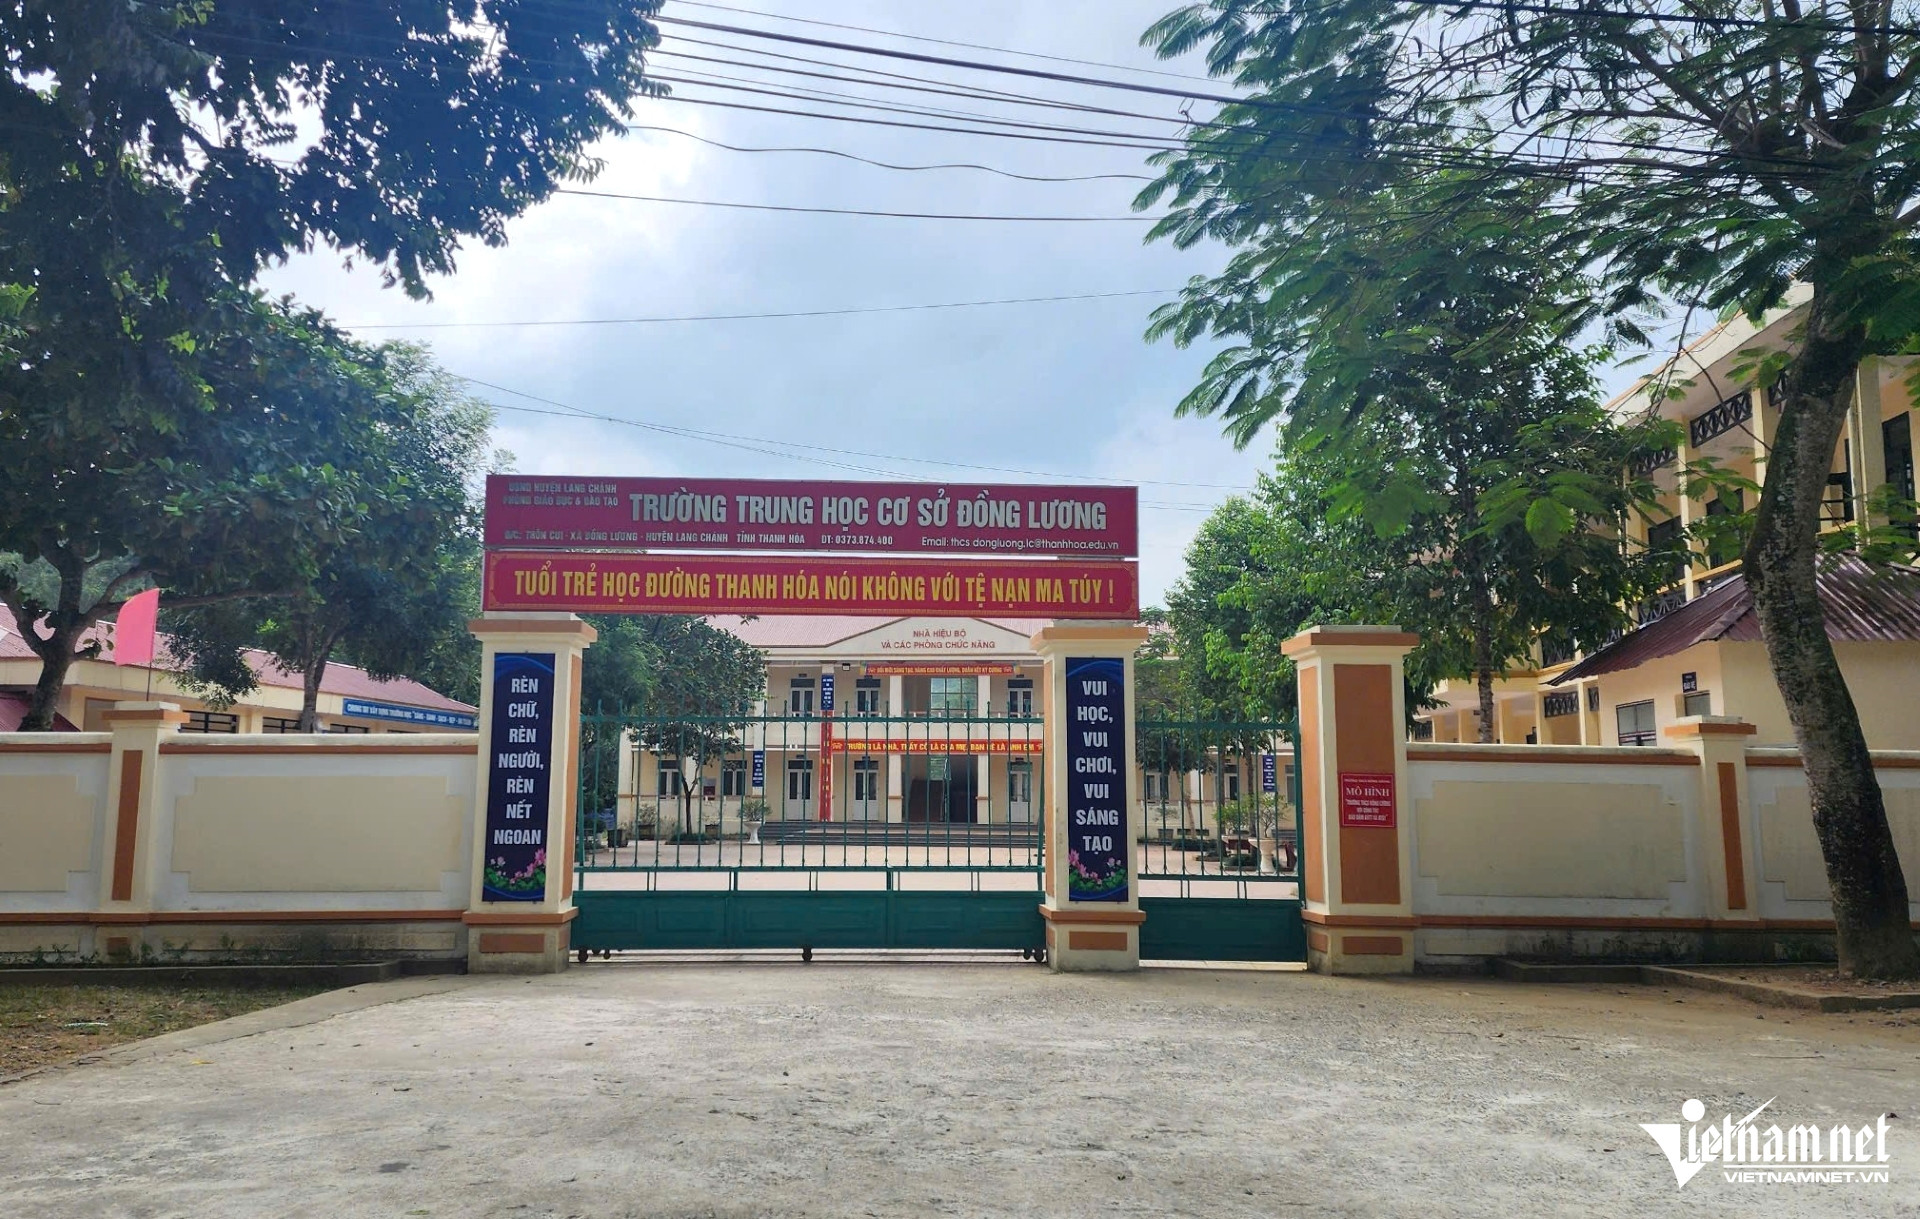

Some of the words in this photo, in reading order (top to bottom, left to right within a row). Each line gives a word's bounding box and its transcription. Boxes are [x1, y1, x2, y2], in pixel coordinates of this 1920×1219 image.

[564, 483, 585, 493] LANG
[604, 496, 618, 507] TẠO
[629, 486, 727, 523] TRƯỜNG
[736, 495, 813, 524] TRUNG
[822, 496, 869, 532] HỌC
[877, 496, 910, 525] CƠ
[917, 488, 950, 527] SỞ
[957, 489, 1021, 529] ĐỒNG
[1028, 499, 1107, 530] LƯƠNG
[646, 531, 673, 544] HUYỆN
[676, 532, 698, 542] LANG
[700, 531, 728, 543] CHÁNH
[737, 531, 755, 543] TỈNH
[759, 533, 786, 543] THANH
[789, 532, 805, 543] HÓA
[835, 534, 893, 545] 0373.874.400
[921, 536, 949, 547] Email:
[515, 560, 557, 596] TUỔI
[563, 562, 597, 597] TRẺ
[603, 572, 640, 603] HỌC
[645, 567, 710, 599] ĐƯỜNG
[715, 574, 778, 599] THANH
[783, 569, 820, 600] HÓA
[825, 570, 857, 601] NÓI
[862, 571, 925, 601] KHÔNG
[931, 571, 960, 602] VỚI
[966, 572, 986, 608] TỆ
[992, 577, 1030, 609] NẠN
[1036, 577, 1065, 603] MA
[1069, 573, 1102, 604] TÚY
[913, 628, 931, 637] NHÀ
[933, 628, 951, 639] HIỆU
[954, 628, 967, 639] BỘ
[881, 640, 891, 649] VÀ
[893, 640, 912, 649] CÁC
[913, 640, 943, 649] PHÒNG
[945, 640, 969, 649] CHỨC
[511, 675, 538, 693] RÈN
[1082, 680, 1107, 696] VUI
[508, 701, 539, 719] CHỮ,
[1077, 705, 1113, 725] HỌC,
[509, 725, 536, 743] RÈN
[1083, 731, 1108, 747] VUI
[873, 742, 881, 750] LÀ
[930, 741, 939, 750] LÀ
[997, 742, 1005, 750] LÀ
[498, 752, 544, 770] NGƯỜI,
[1075, 757, 1117, 775] CHƠI,
[506, 776, 534, 794] RÈN
[1084, 783, 1109, 799] VUI
[1346, 785, 1362, 795] MÔ
[1364, 786, 1390, 796] HÌNH
[506, 799, 532, 819] NẾT
[1076, 807, 1118, 826] SÁNG
[494, 829, 541, 845] NGOAN
[1083, 835, 1112, 855] TẠO
